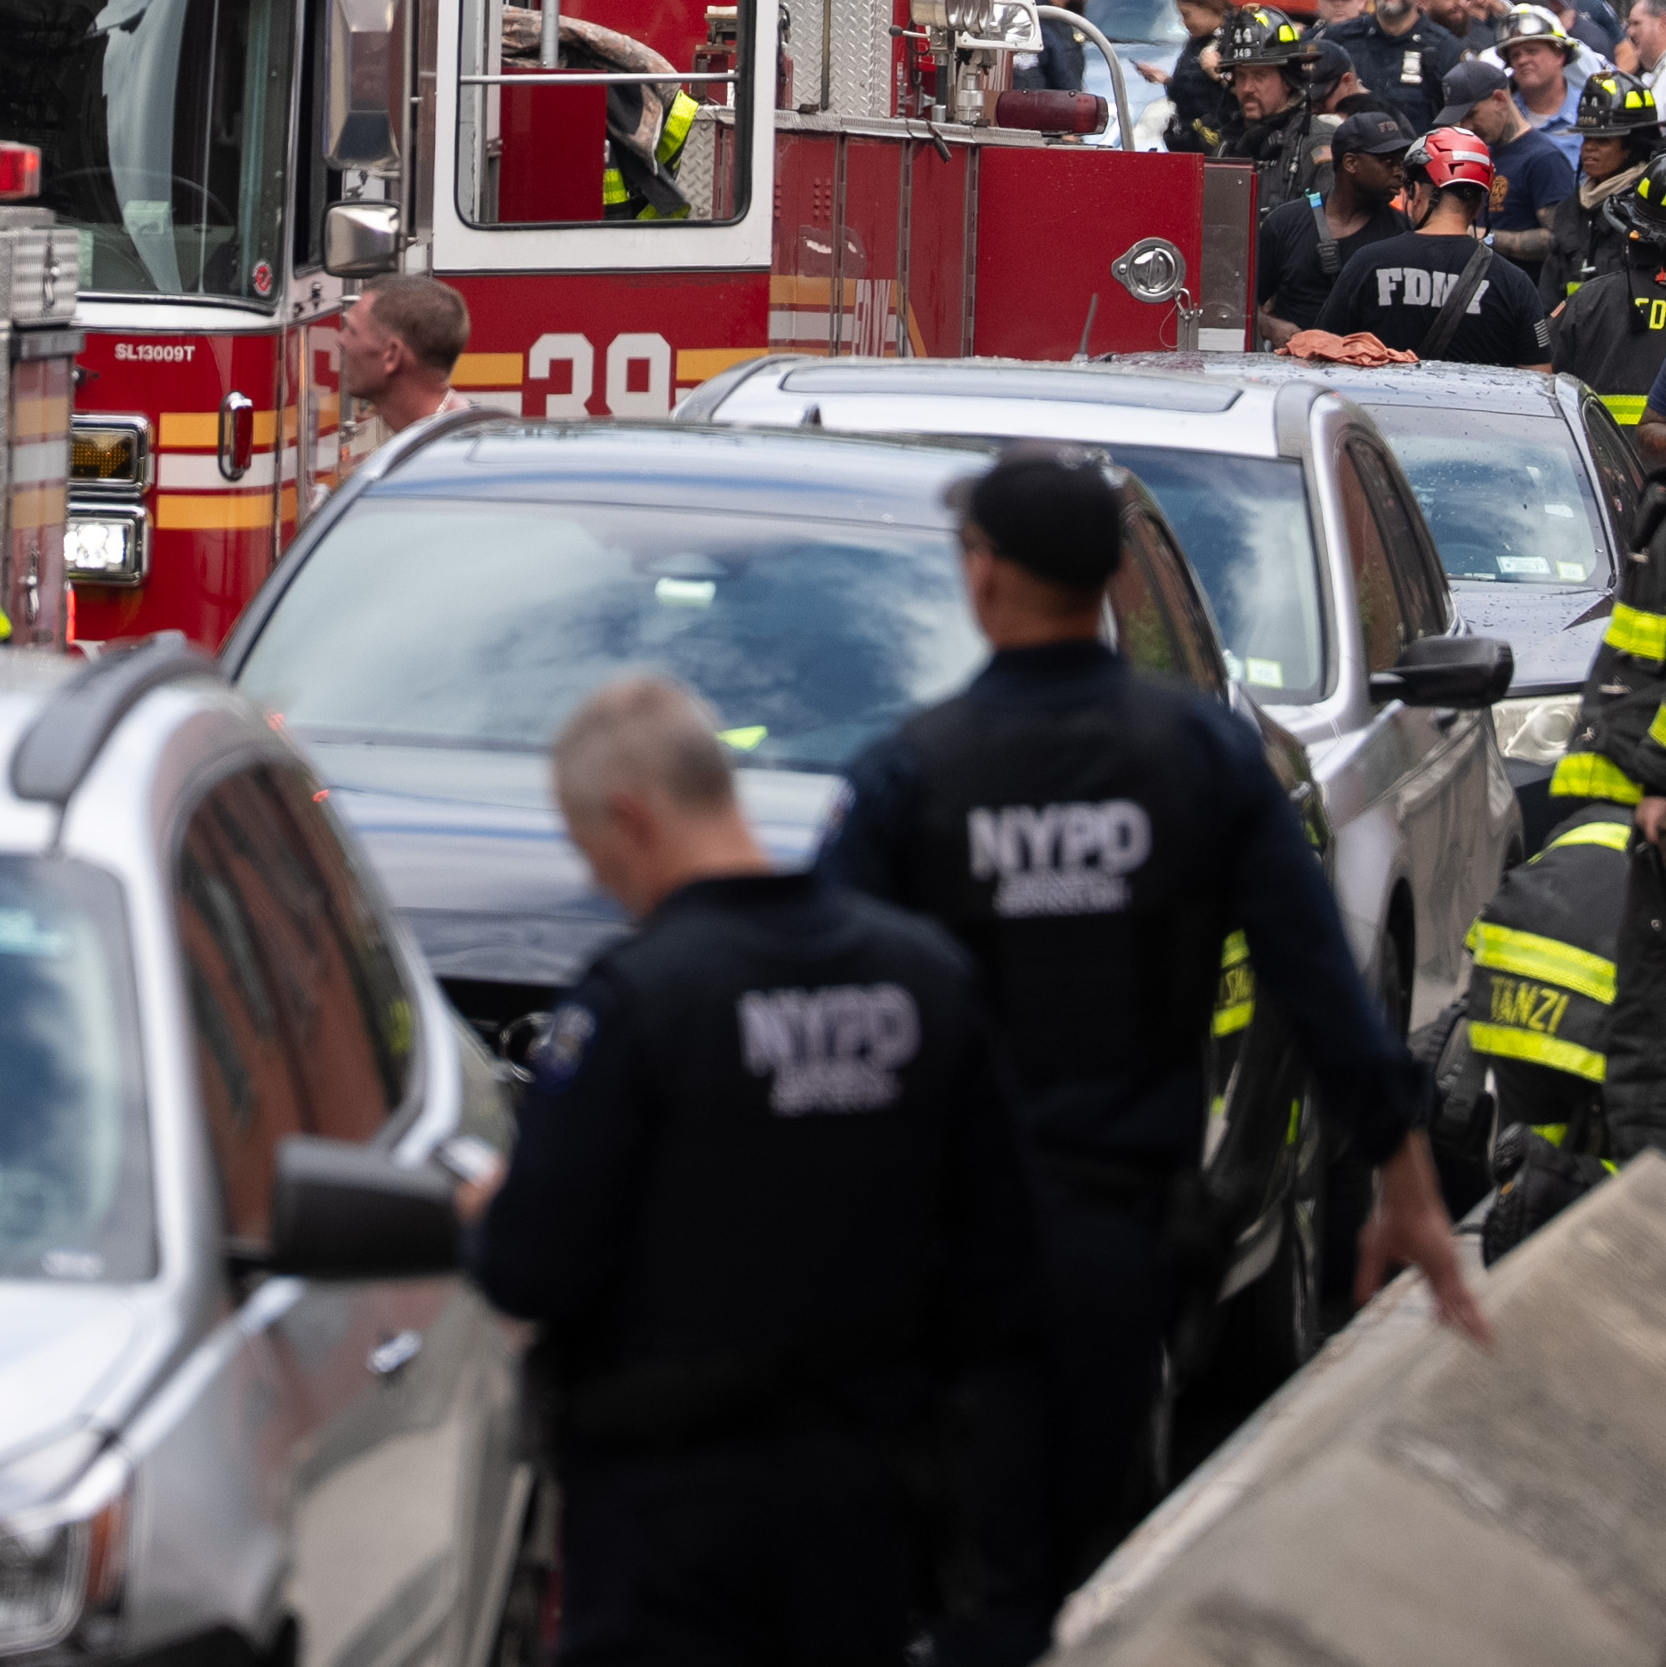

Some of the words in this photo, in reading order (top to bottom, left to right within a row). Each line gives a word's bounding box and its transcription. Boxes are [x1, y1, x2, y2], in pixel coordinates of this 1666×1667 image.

[114, 342, 196, 363] SL13009T
[528, 333, 671, 418] 39
[967, 808, 1152, 882] NYPD
[737, 982, 922, 1079] NYPD
